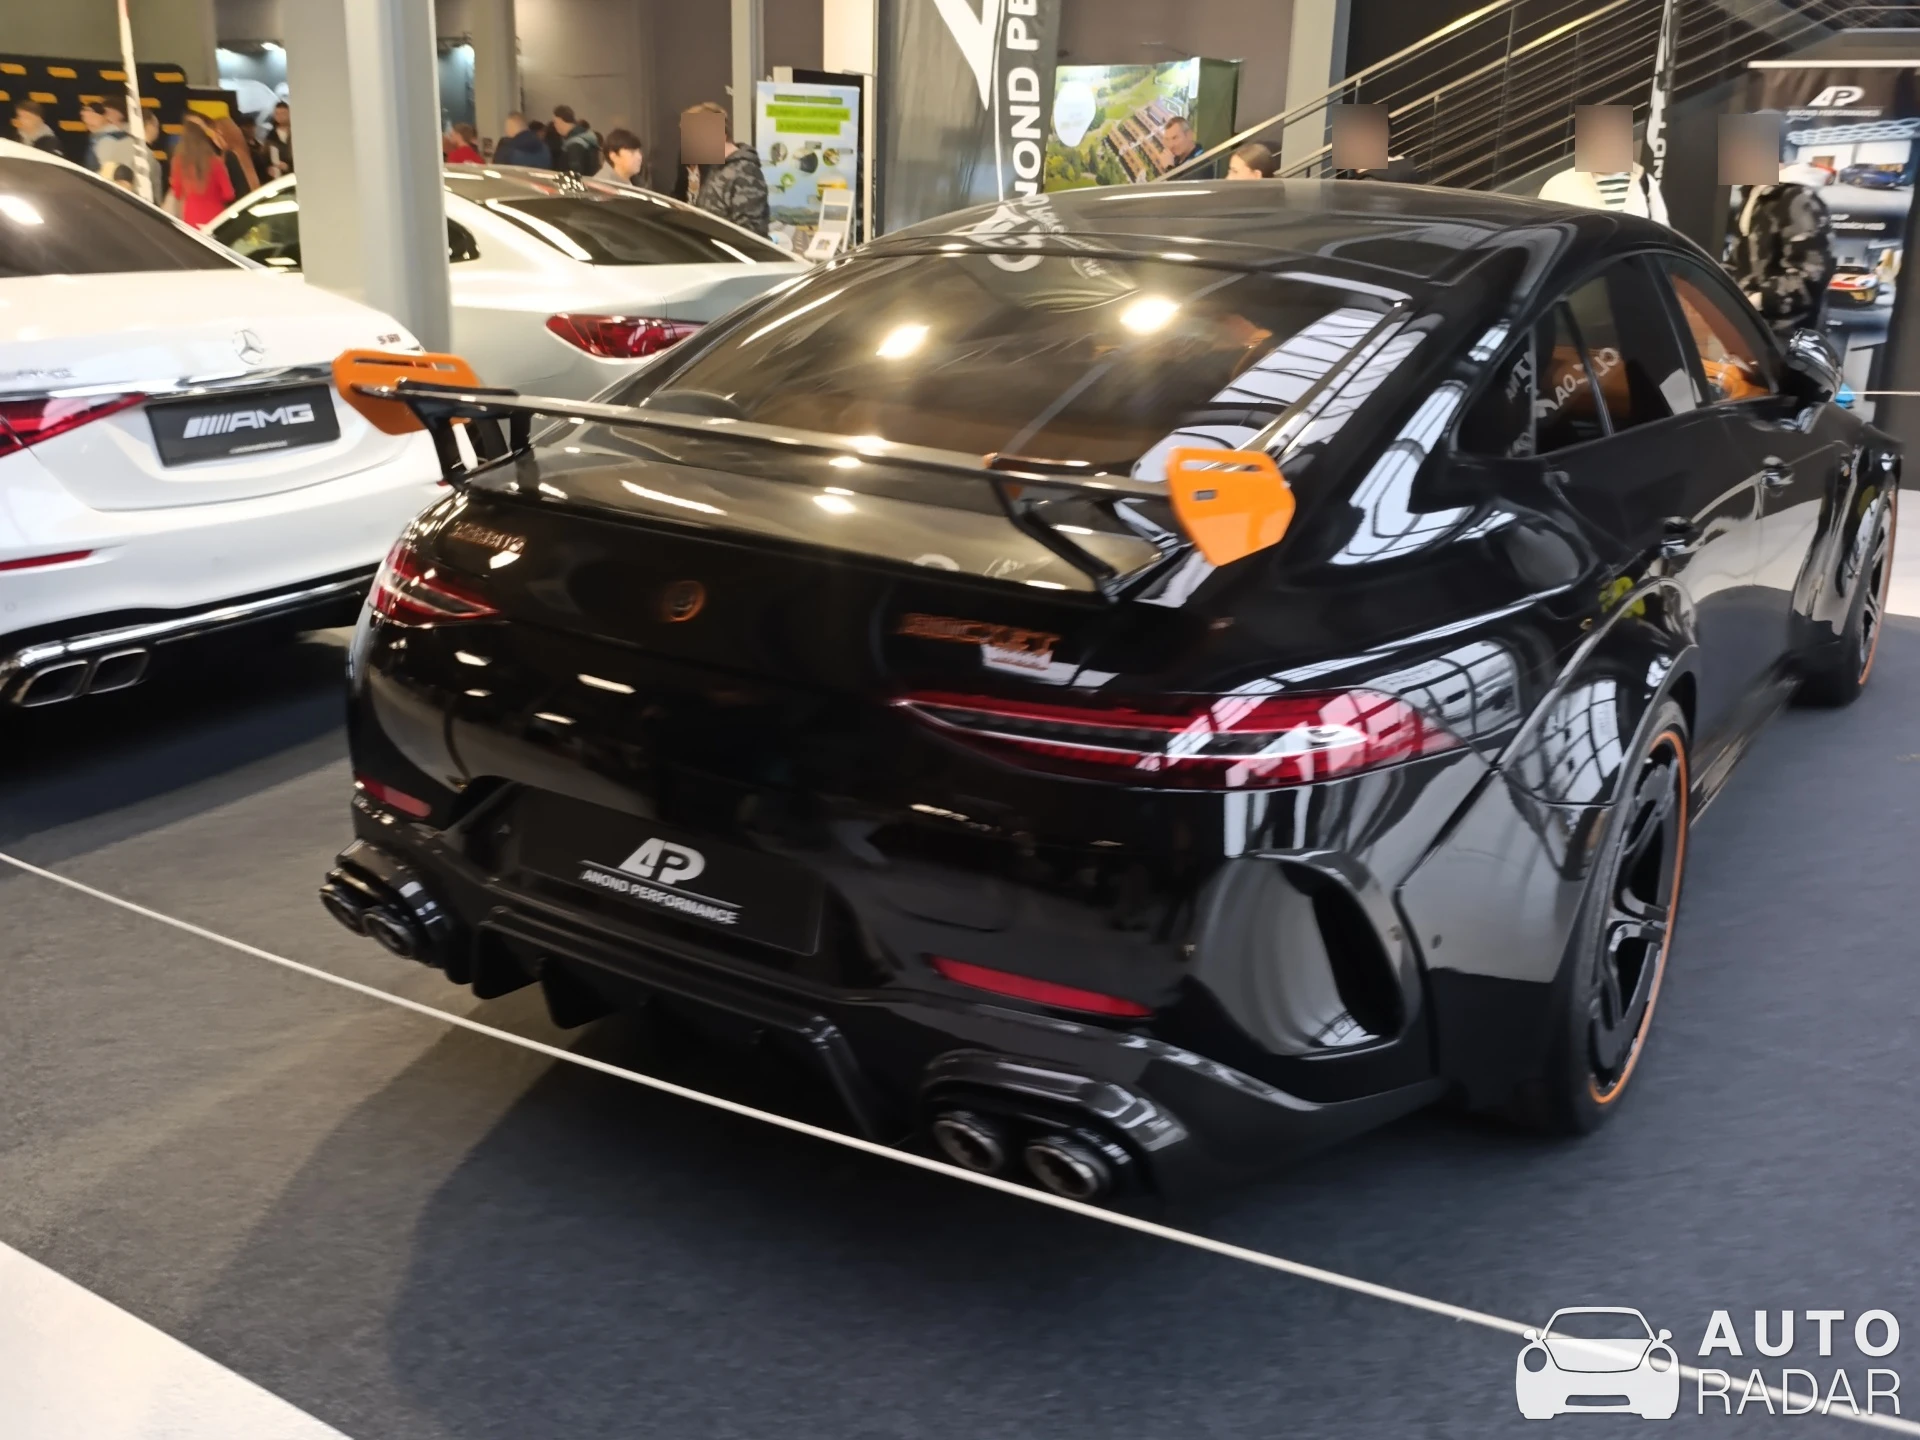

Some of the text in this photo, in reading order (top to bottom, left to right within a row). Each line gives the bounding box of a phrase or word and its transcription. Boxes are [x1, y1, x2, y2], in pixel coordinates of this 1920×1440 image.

[227, 403, 315, 433] AMG
[618, 837, 705, 885] AP
[630, 883, 741, 925] PERFORMANCE
